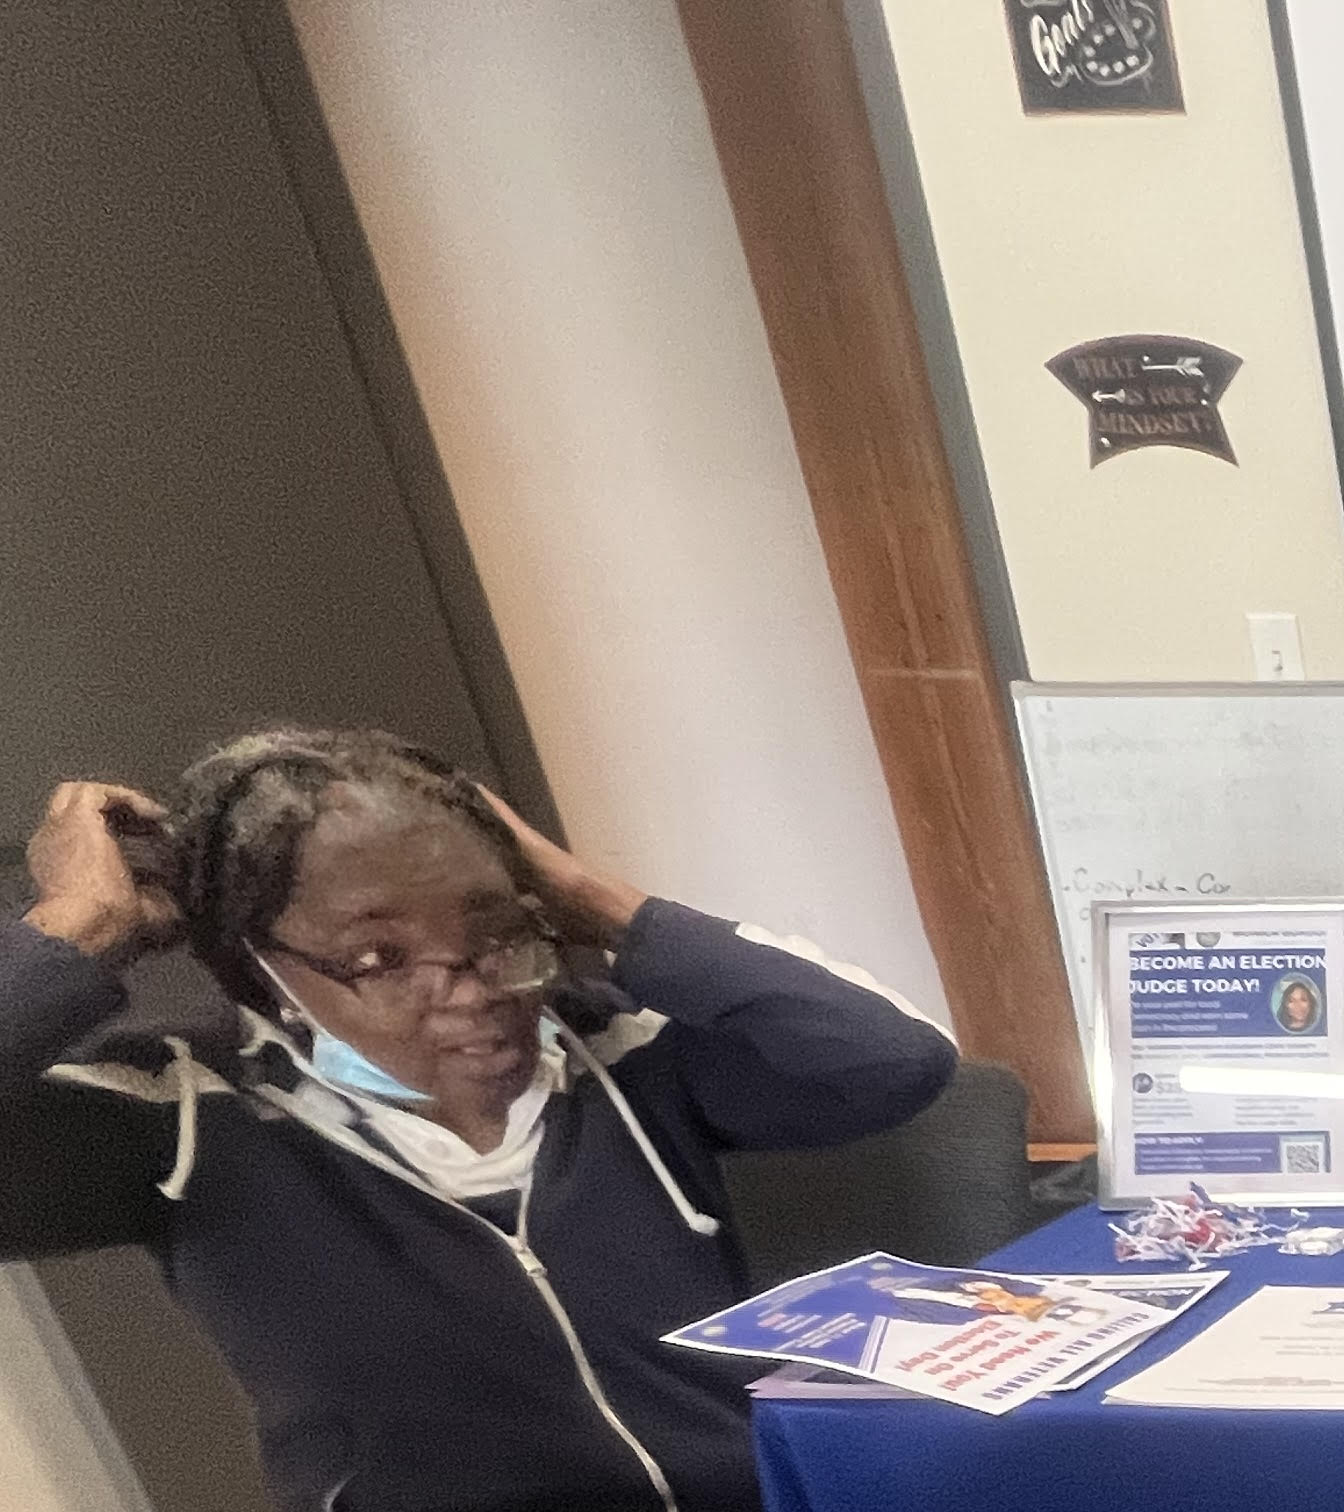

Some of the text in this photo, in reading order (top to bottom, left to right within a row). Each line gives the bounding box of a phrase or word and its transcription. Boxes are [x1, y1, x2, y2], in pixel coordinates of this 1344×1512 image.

[1072, 356, 1137, 379] WHAT
[1149, 386, 1199, 404] YOUR
[1129, 954, 1327, 972] BECOME AN ELECTION
[1129, 977, 1260, 994] JUDGE TODAY!
